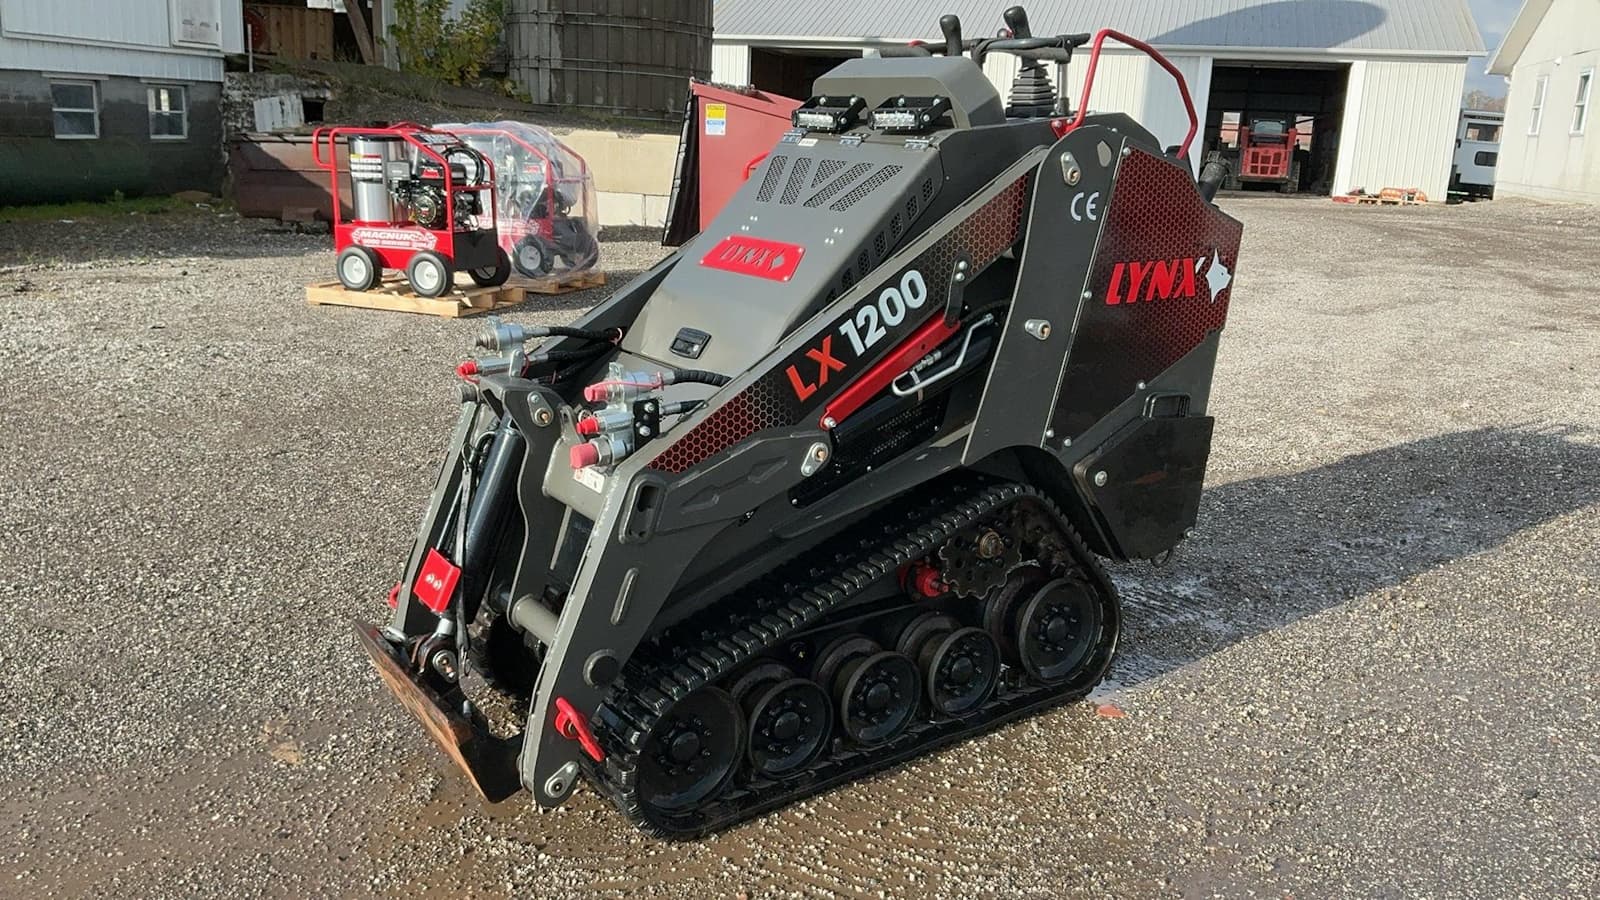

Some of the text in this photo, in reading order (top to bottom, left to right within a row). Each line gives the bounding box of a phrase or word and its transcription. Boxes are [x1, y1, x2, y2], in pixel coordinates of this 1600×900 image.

[1070, 191, 1100, 222] CE
[360, 230, 413, 241] MAGNUM
[719, 243, 774, 268] LYNX
[1105, 257, 1196, 306] LYNX
[785, 269, 928, 403] LX 1200
